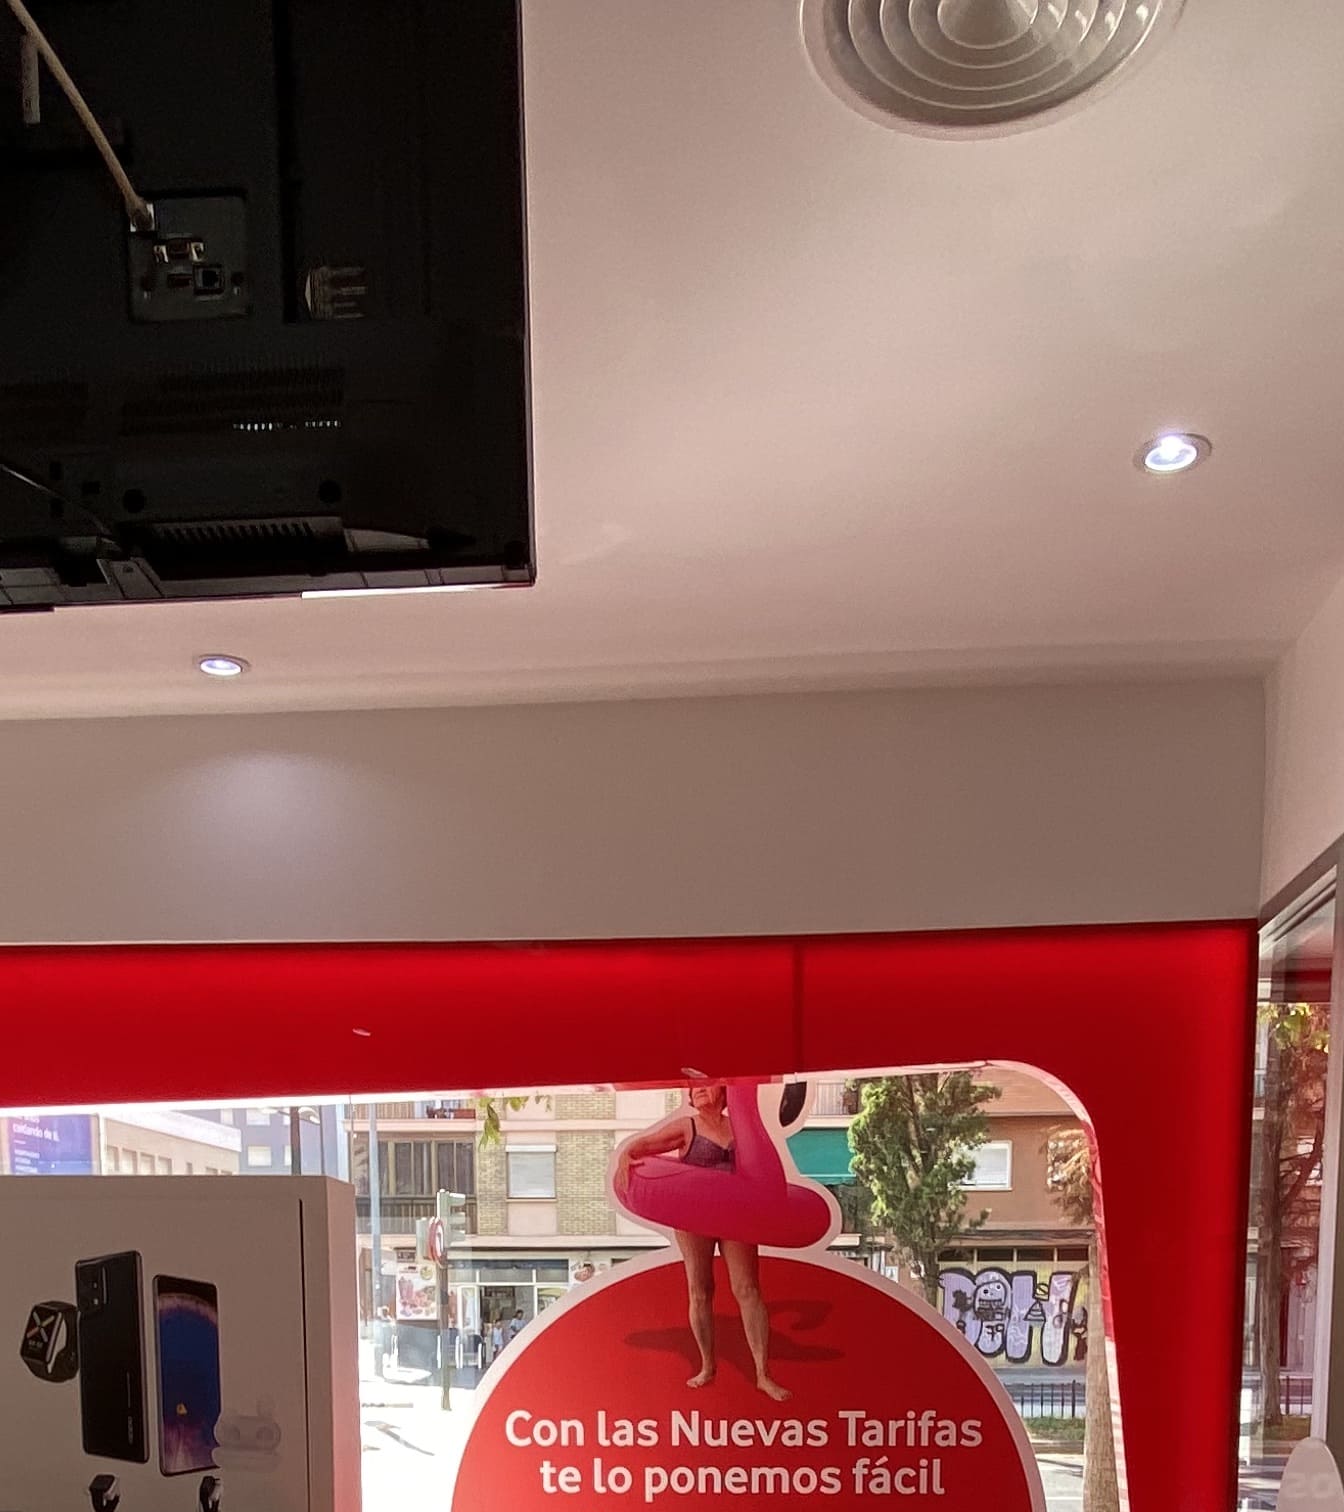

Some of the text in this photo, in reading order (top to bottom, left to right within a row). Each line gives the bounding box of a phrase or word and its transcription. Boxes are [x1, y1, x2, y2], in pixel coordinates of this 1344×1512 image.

[505, 1410, 983, 1447] Con las Nuevas Tarifas
[540, 1456, 945, 1503] te lo ponemos fácil
